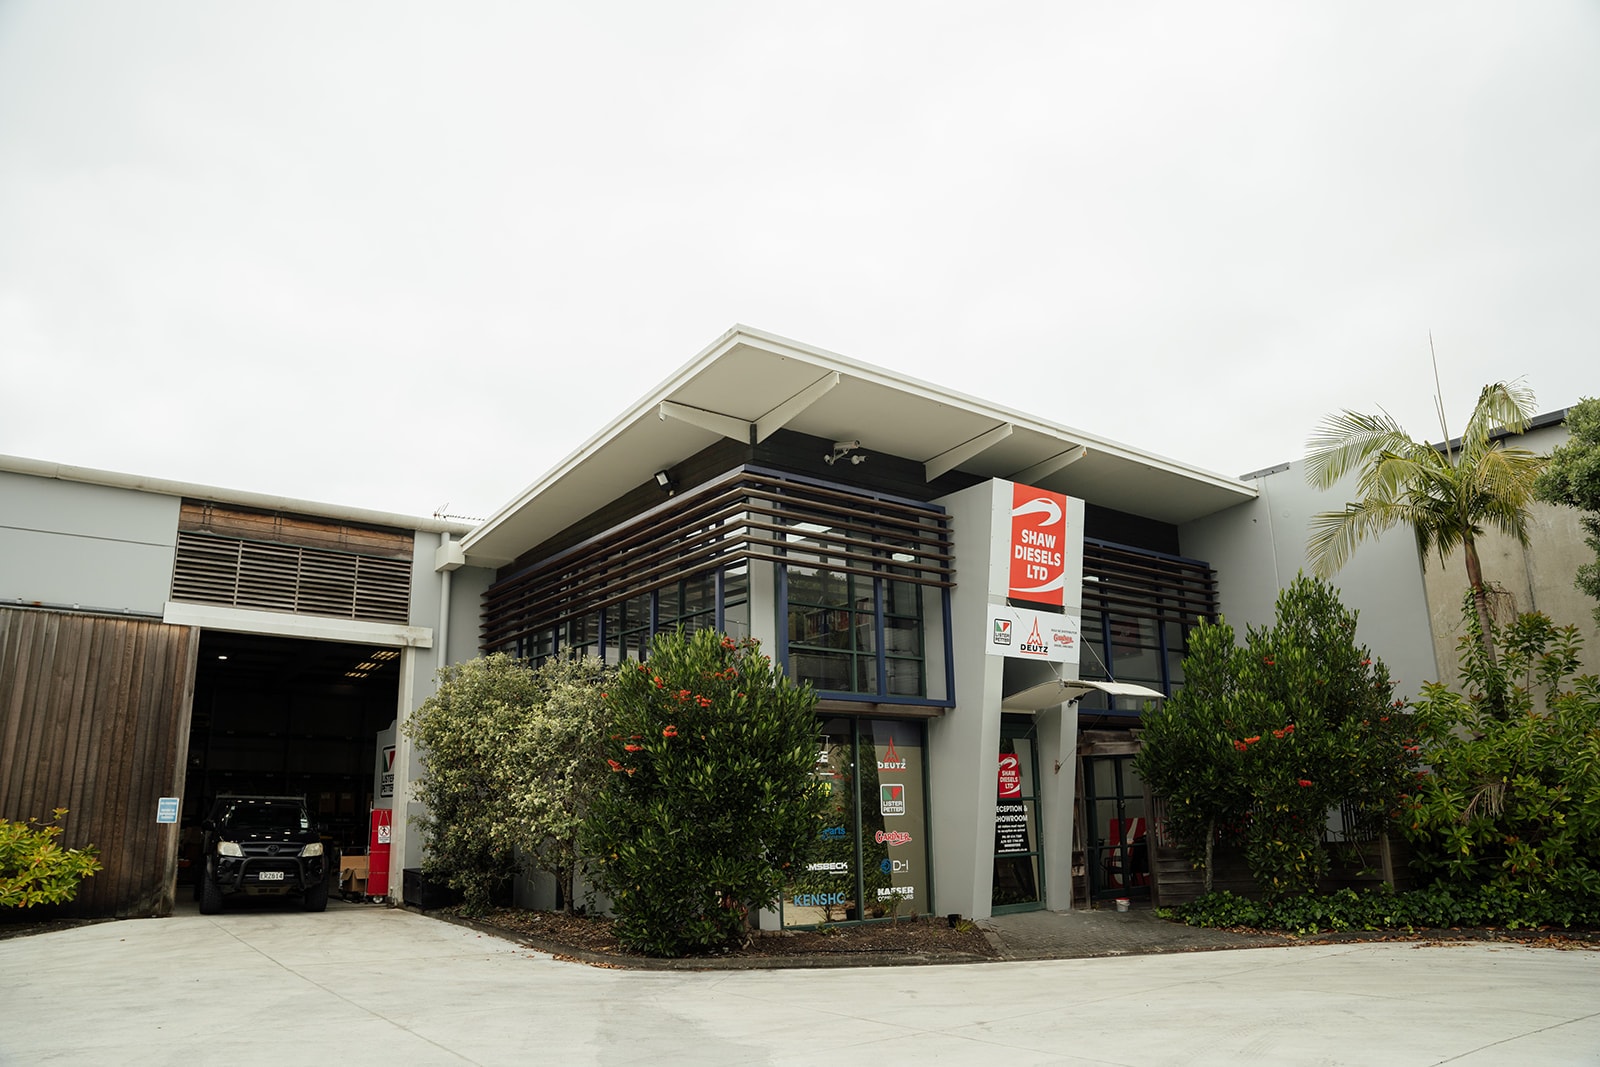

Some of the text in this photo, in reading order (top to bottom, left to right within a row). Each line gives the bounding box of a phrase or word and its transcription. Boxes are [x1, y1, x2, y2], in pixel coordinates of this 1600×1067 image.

[1021, 528, 1056, 549] SHAW
[1014, 544, 1062, 567] DIESELS
[1026, 564, 1048, 581] LTD
[1020, 644, 1048, 653] DEUTZ
[877, 761, 906, 769] DEUTZ
